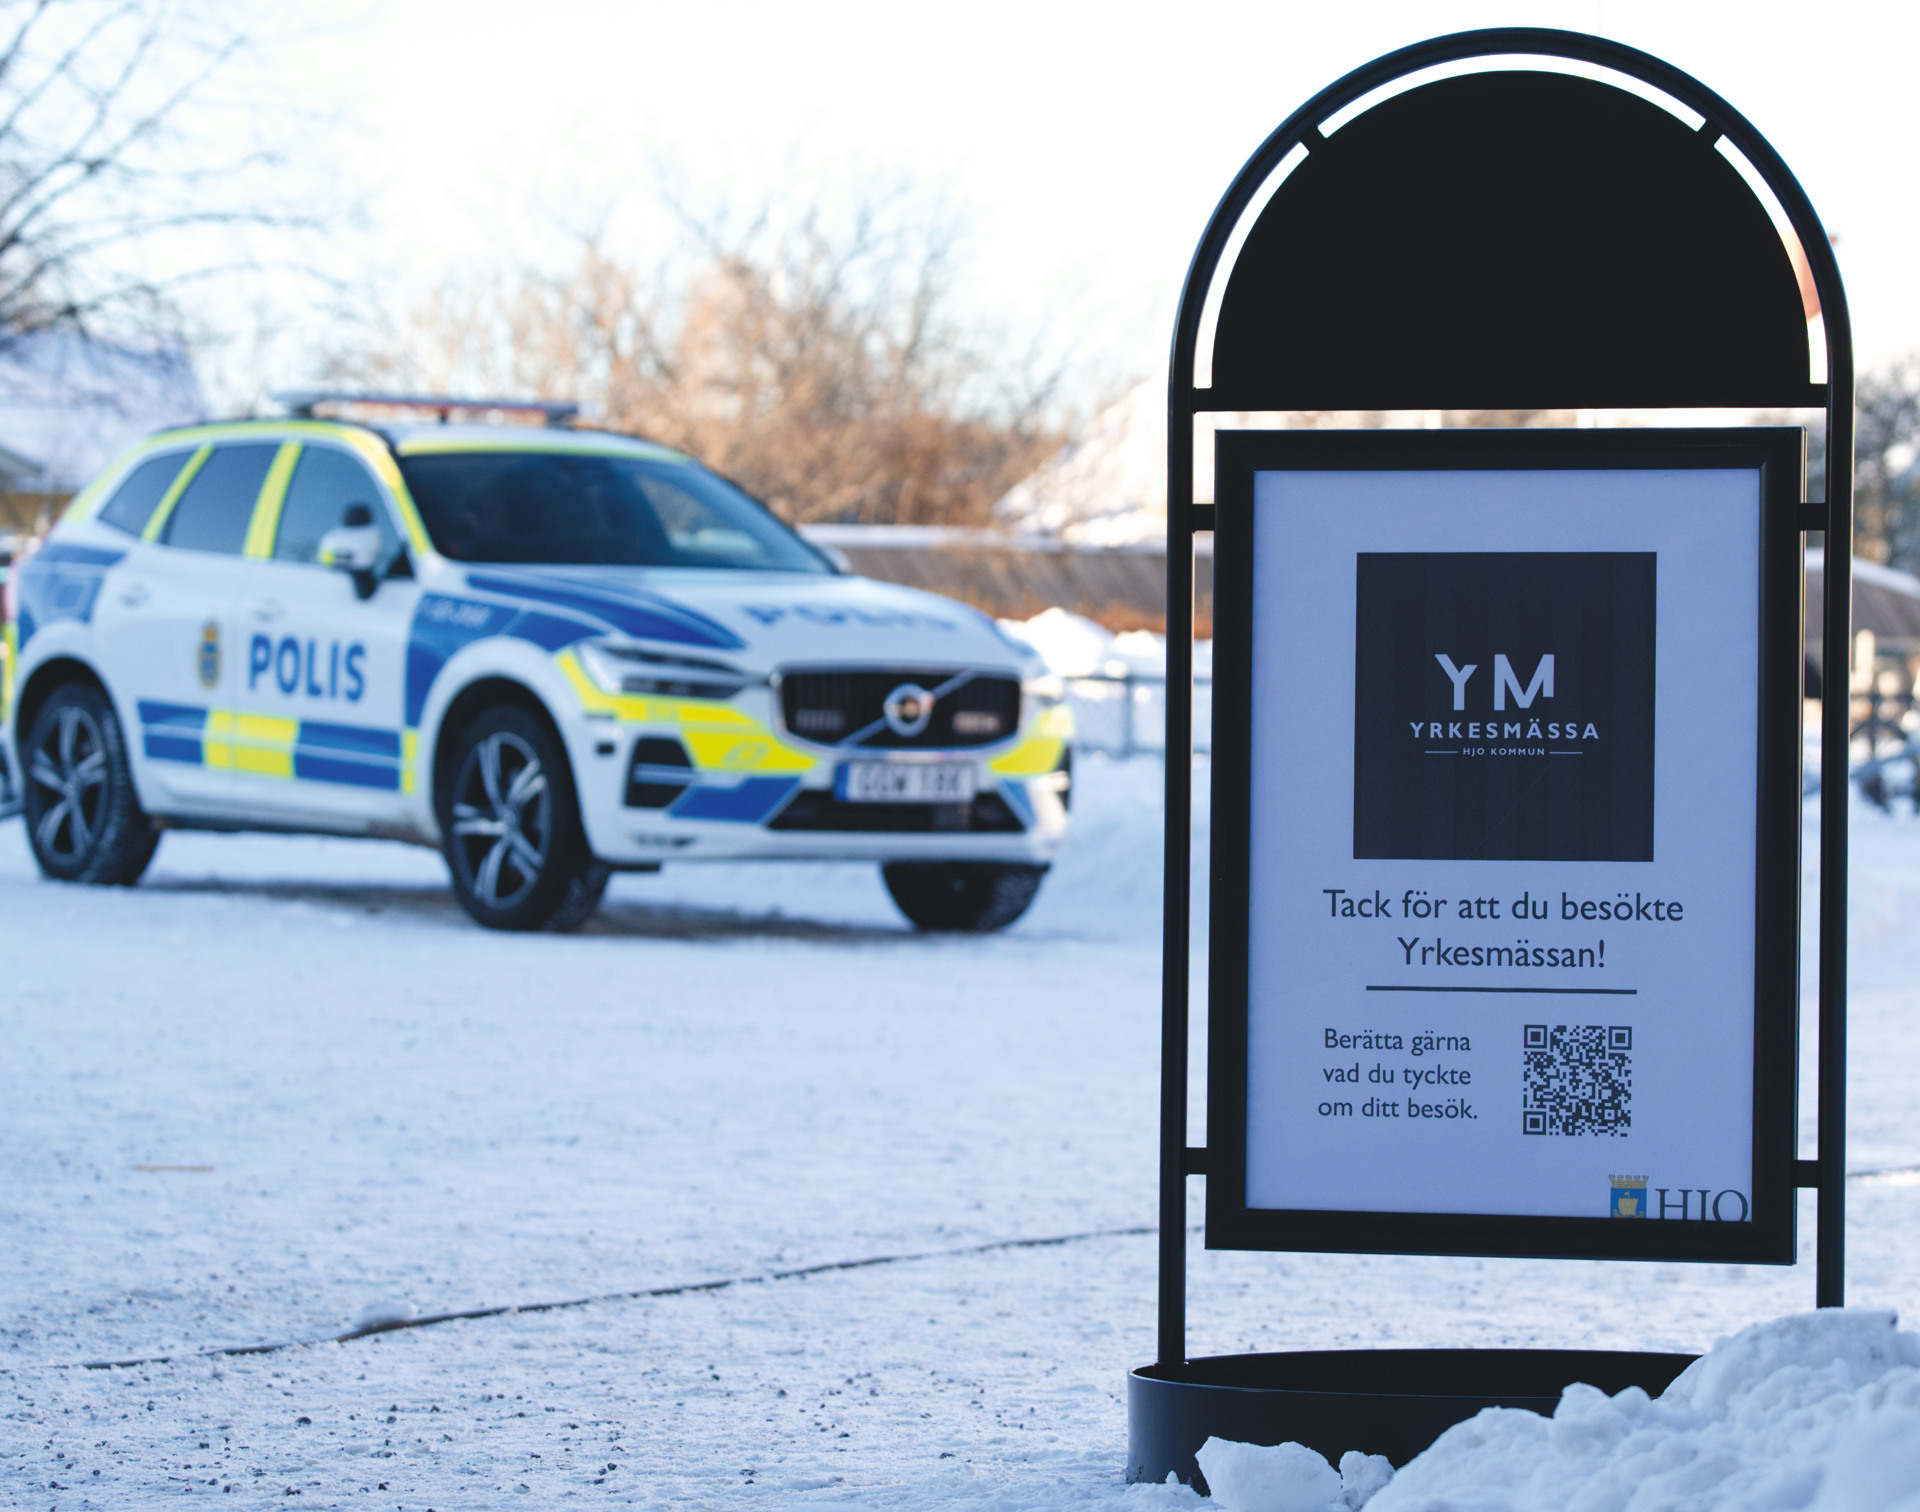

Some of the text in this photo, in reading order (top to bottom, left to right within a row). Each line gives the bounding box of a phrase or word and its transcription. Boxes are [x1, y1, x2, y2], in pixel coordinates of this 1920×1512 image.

[247, 633, 366, 702] POLIS
[1434, 653, 1555, 711] YM
[1409, 718, 1599, 740] YRKESMÄSSA
[1462, 747, 1545, 757] HJO KOMMUN
[1322, 889, 1684, 922] Tack för att du besökte
[1397, 936, 1606, 969] Yrkesmässan!
[1324, 1027, 1472, 1057] Berätta gärna
[1322, 1062, 1472, 1091] vad du tyckte
[1317, 1096, 1479, 1120] om ditt besök.
